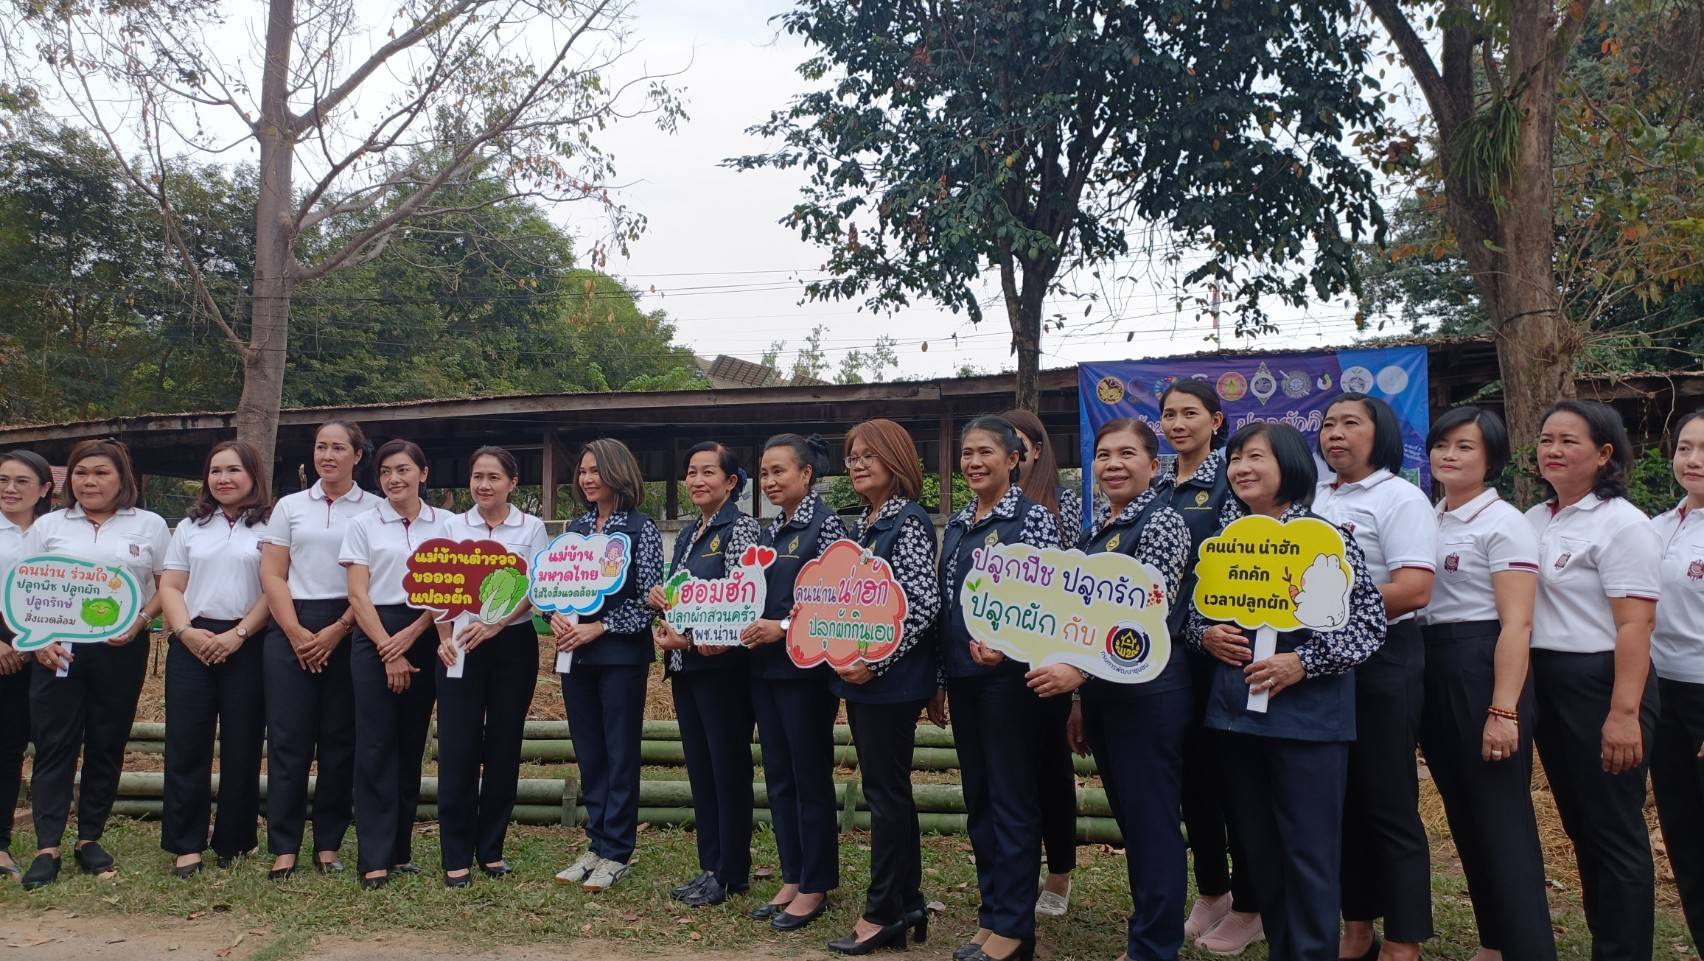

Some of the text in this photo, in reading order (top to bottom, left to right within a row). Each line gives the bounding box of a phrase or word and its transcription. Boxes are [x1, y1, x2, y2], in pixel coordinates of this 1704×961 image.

[548, 544, 594, 562] แม่บ้าน
[1206, 538, 1300, 555] คนน่าน น่าฮัก
[415, 546, 517, 566] แม่บ้านตำรวจ
[18, 564, 108, 582] คนน่าน ร่วมใจ
[412, 571, 465, 585] ขออวด
[538, 565, 599, 582] มหาดไทย
[973, 546, 1146, 609] ปลูกพืช ปลูกรัก
[1228, 565, 1270, 581] คึกคัก
[16, 579, 101, 598] ปลูกพืช ปลูกผัก
[681, 571, 756, 604] ฮอมฮัก
[795, 559, 890, 606] คนน่าน น่าฮัก
[411, 588, 473, 605] แปลงผัก
[1204, 593, 1289, 613] เวลาปลูกผัก
[24, 609, 77, 626] สิ่งแวดล้อม
[667, 605, 757, 629] ปลูกผักสวนครัว
[971, 592, 1096, 646] ปลูกผัก กับ
[695, 625, 738, 641] พช.น่าน
